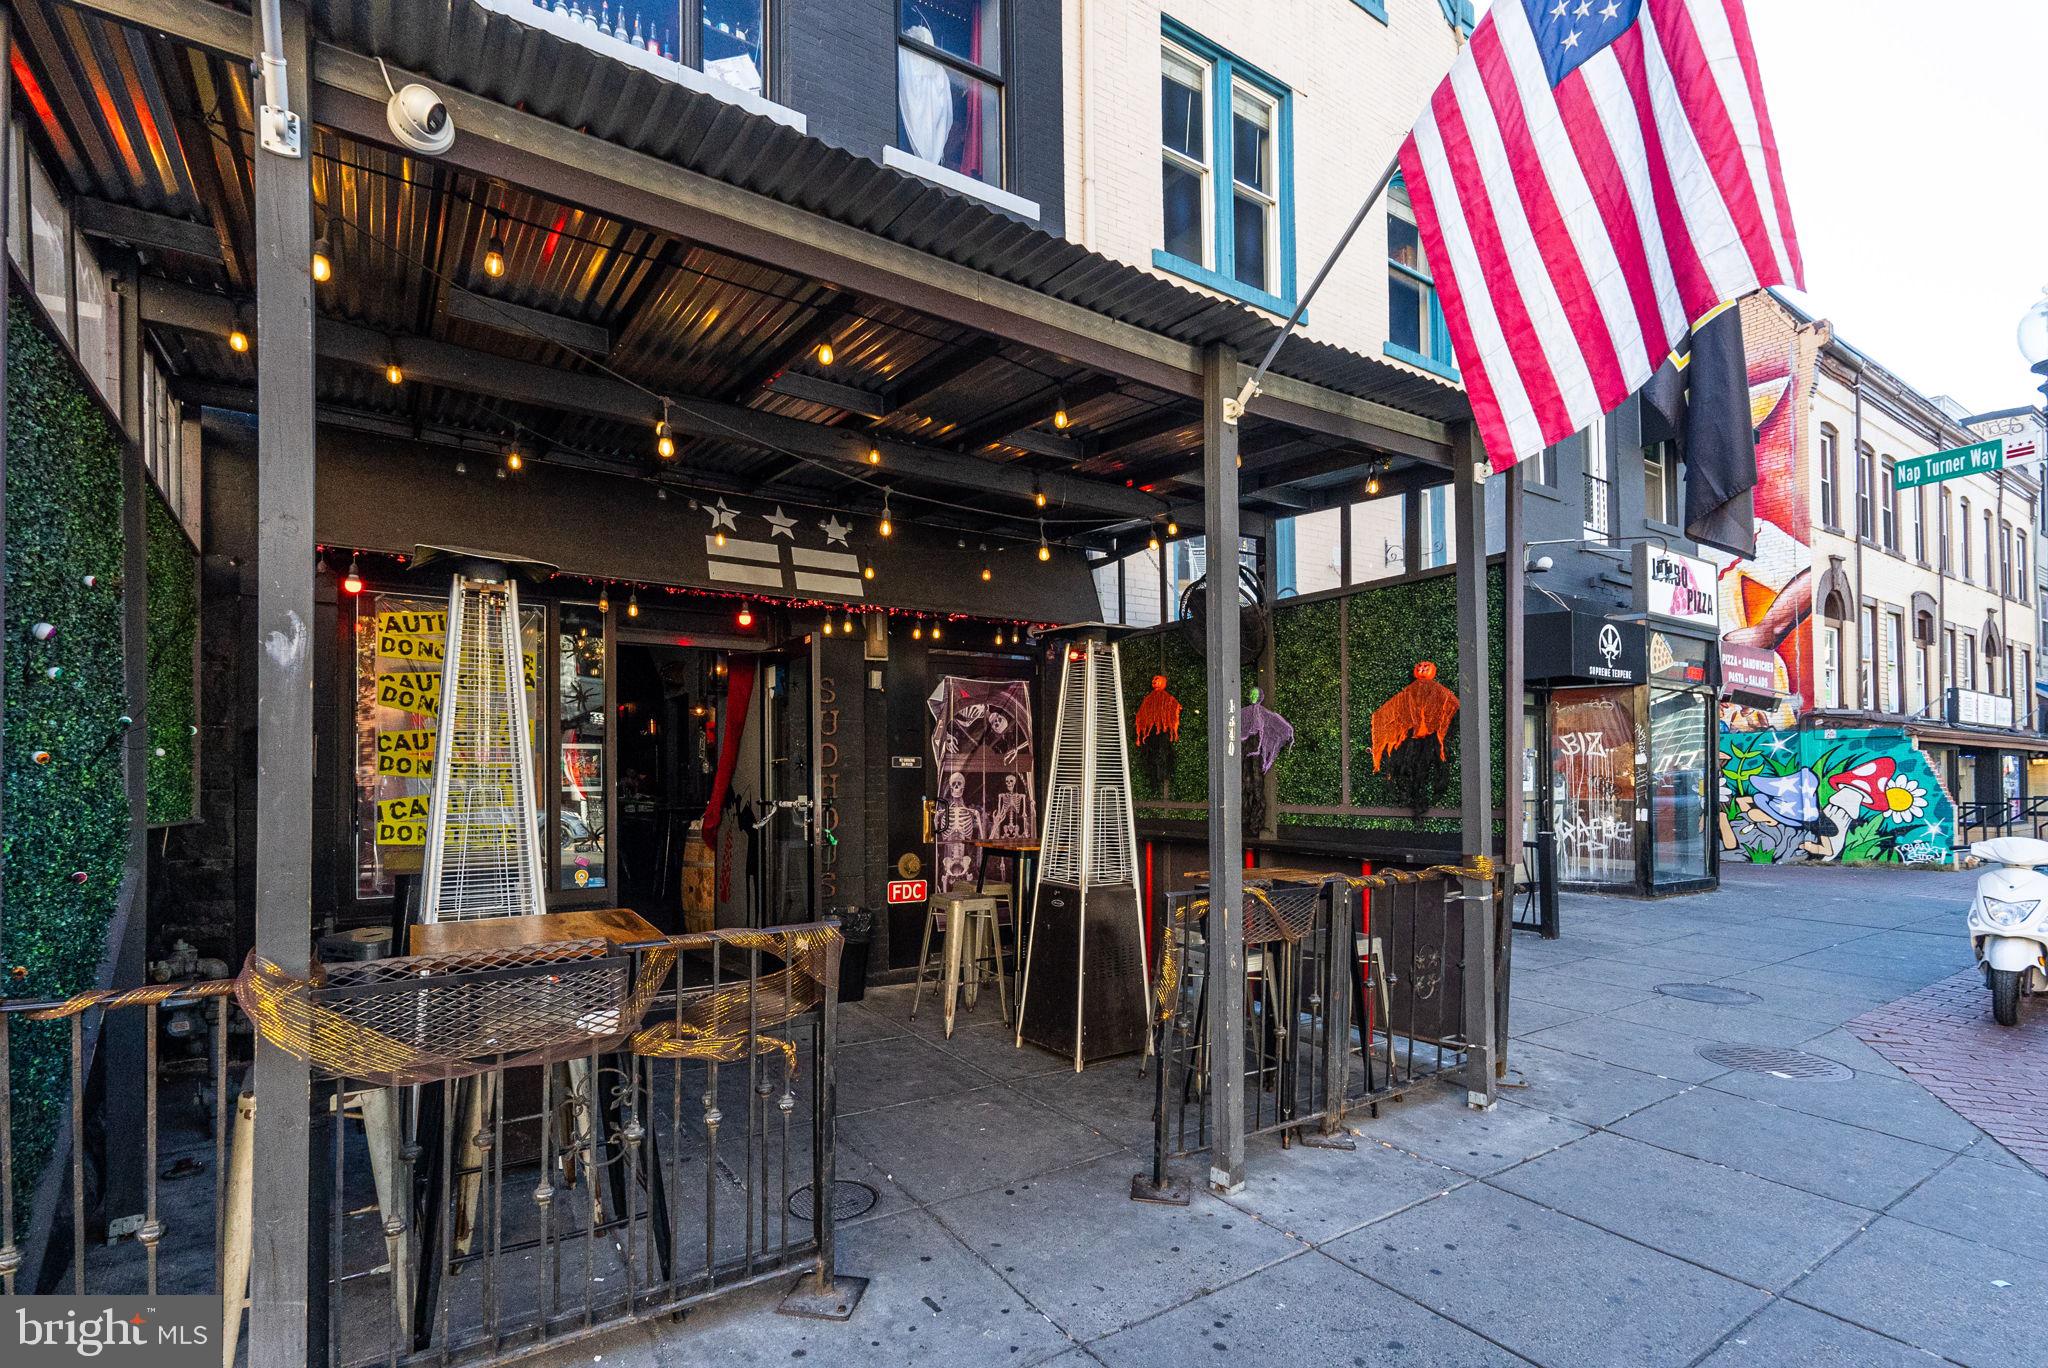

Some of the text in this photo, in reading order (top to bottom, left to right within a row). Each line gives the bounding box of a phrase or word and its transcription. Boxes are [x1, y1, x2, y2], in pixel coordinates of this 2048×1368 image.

[1897, 447, 1997, 484] Nap Turner Way
[1687, 589, 1713, 615] PIZZA
[382, 637, 413, 655] DO
[1722, 653, 1738, 666] PIZZA
[1589, 666, 1632, 680] SUPREME TERPENE
[1728, 671, 1745, 683] PASTA
[382, 686, 414, 707] DO
[379, 755, 412, 773] DO
[380, 825, 413, 841] DO
[892, 883, 922, 900] FDC
